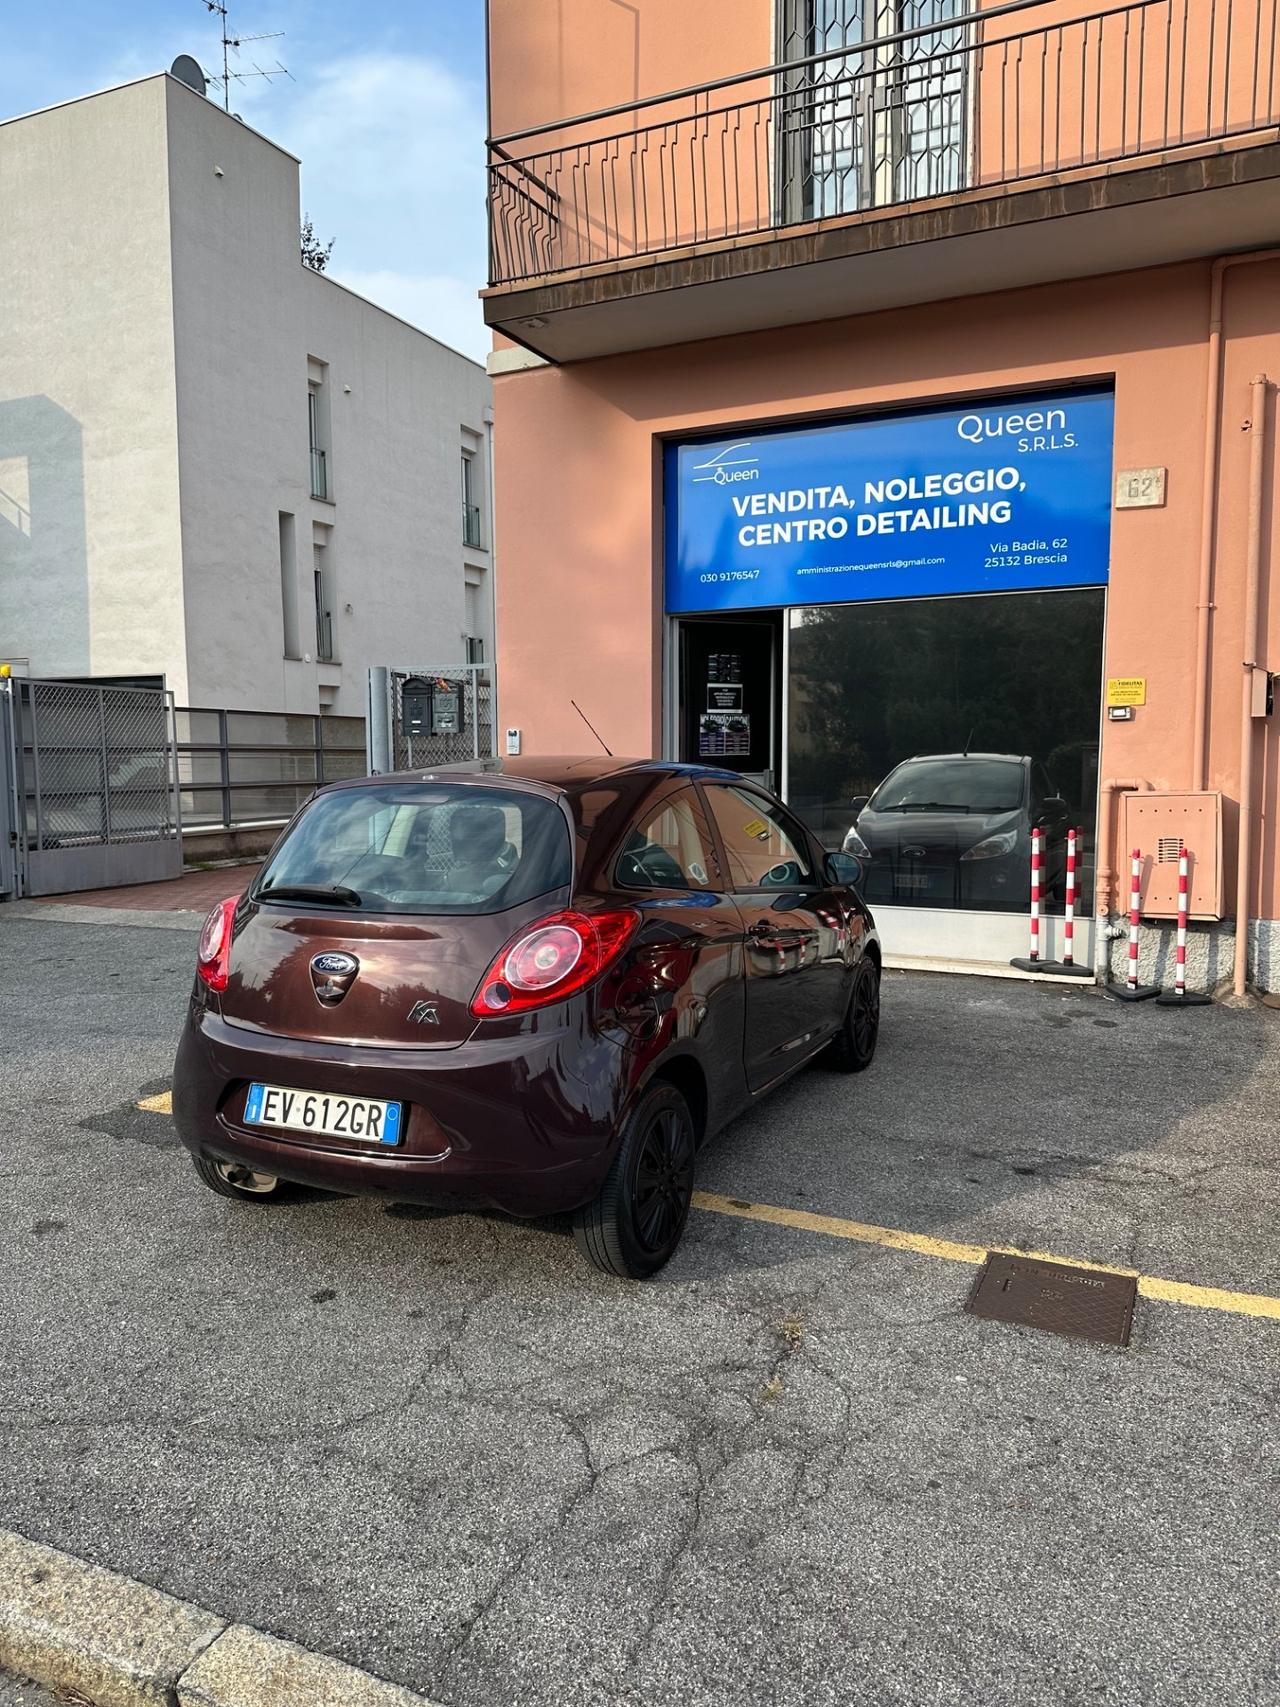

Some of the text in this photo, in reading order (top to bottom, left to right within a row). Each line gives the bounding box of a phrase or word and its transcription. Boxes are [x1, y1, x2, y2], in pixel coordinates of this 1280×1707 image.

[957, 408, 1066, 443] Queen
[1018, 433, 1080, 452] S.R.L.S.
[714, 467, 759, 486] Queen
[731, 467, 1027, 517] VENDITA, NOLEGGIO,
[738, 500, 1012, 547] CENTRO DETAILING
[990, 538, 1068, 553] Via Badia, 62
[797, 556, 946, 575] amministrazionequeensrls@gmail.com
[984, 553, 1068, 568] 25132 Brescia
[700, 570, 760, 583] 030 9176547
[318, 957, 351, 971] Ford
[263, 1090, 382, 1137] EV 612GR
